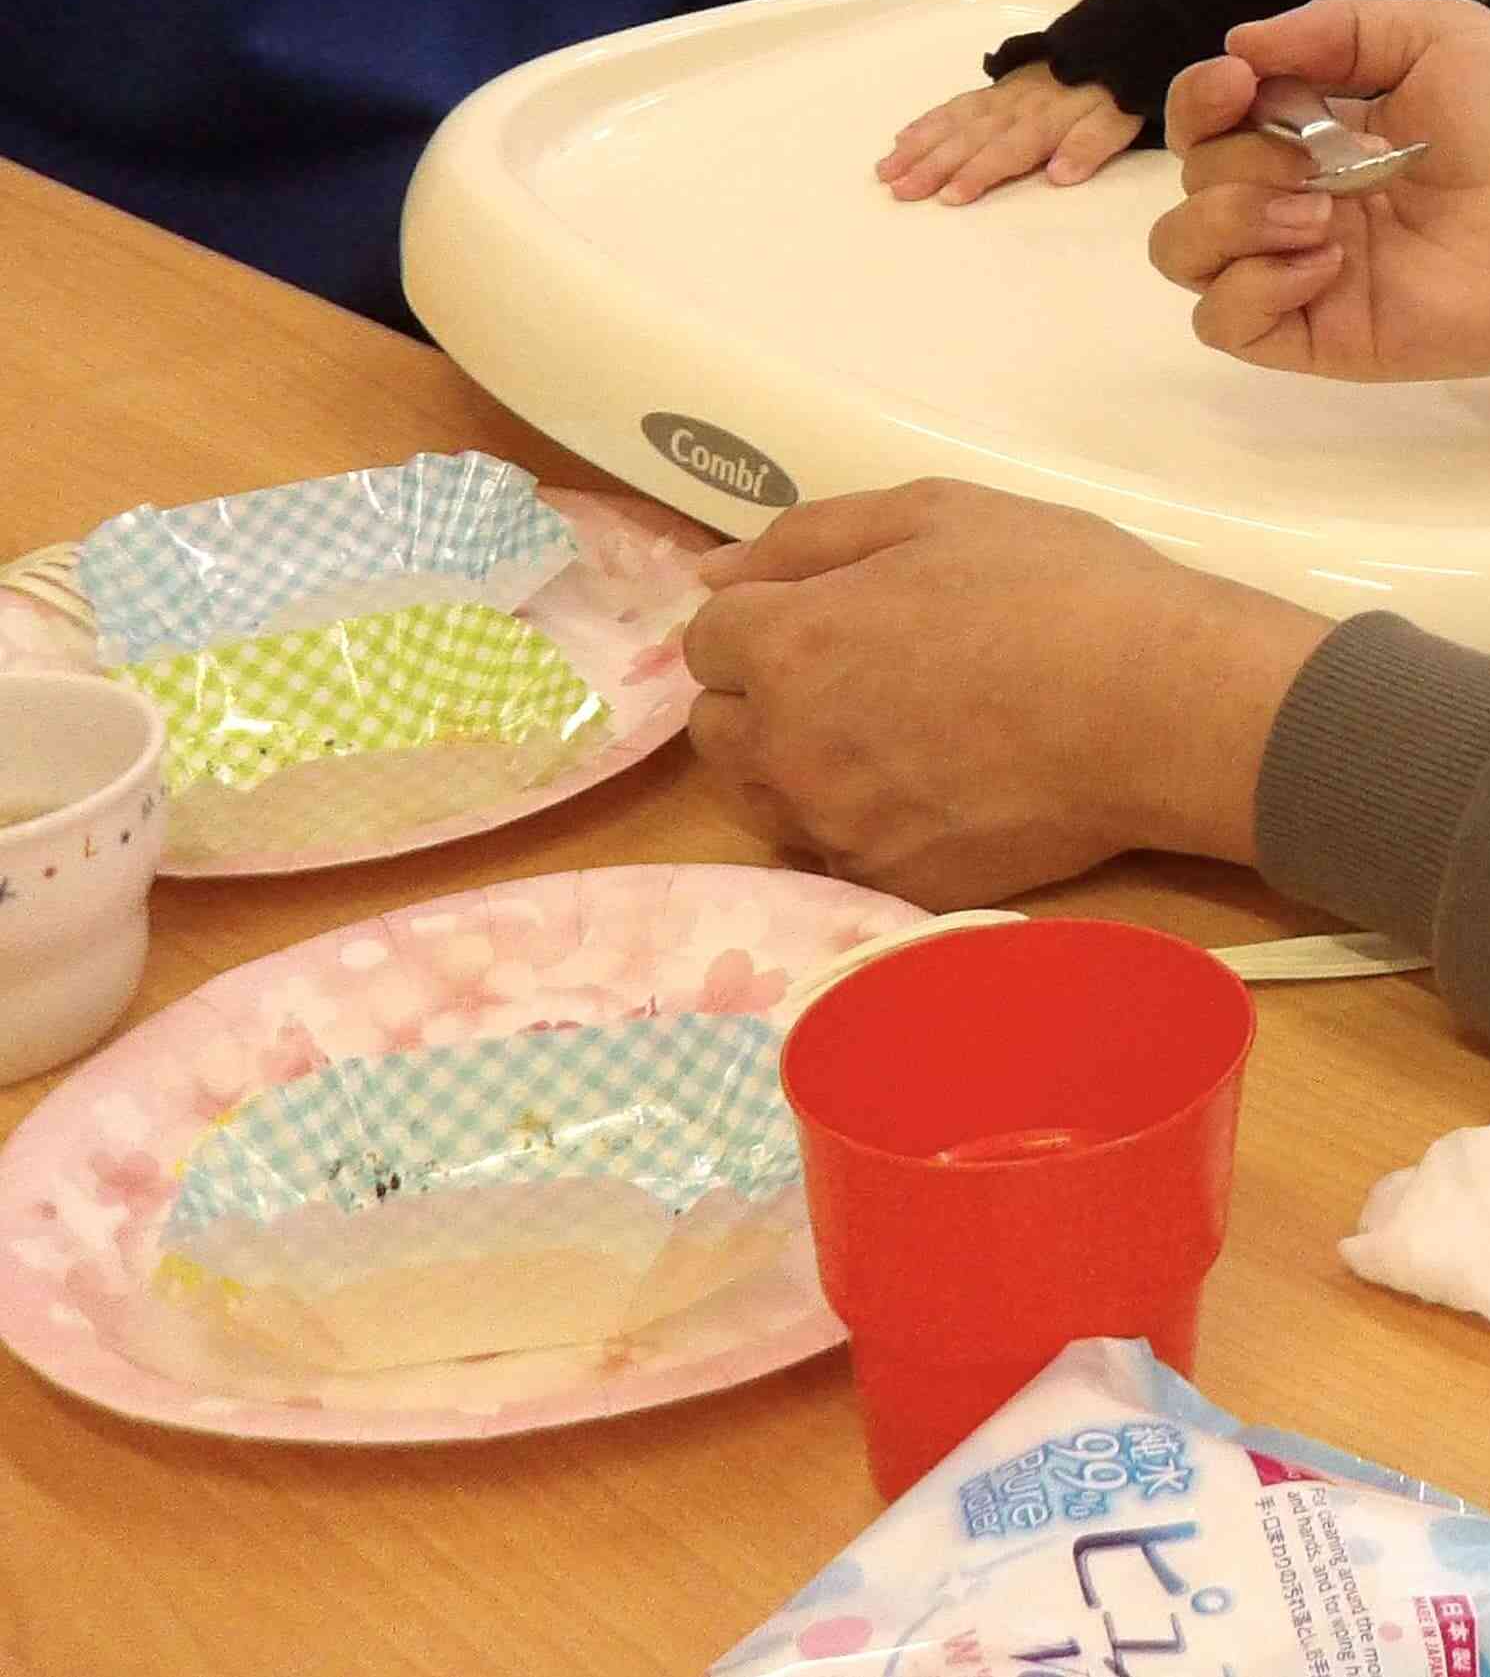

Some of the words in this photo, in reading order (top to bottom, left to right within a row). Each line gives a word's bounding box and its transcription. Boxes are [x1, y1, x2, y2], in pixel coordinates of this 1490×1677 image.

[671, 428, 770, 498] Combi
[1286, 1491, 1307, 1515] and
[1312, 1565, 1333, 1593] and
[1317, 1509, 1348, 1566] cleaning
[1338, 1567, 1366, 1615] around
[1356, 1616, 1375, 1643] the
[1323, 1594, 1341, 1616] for
[1330, 1616, 1356, 1661] wiping
